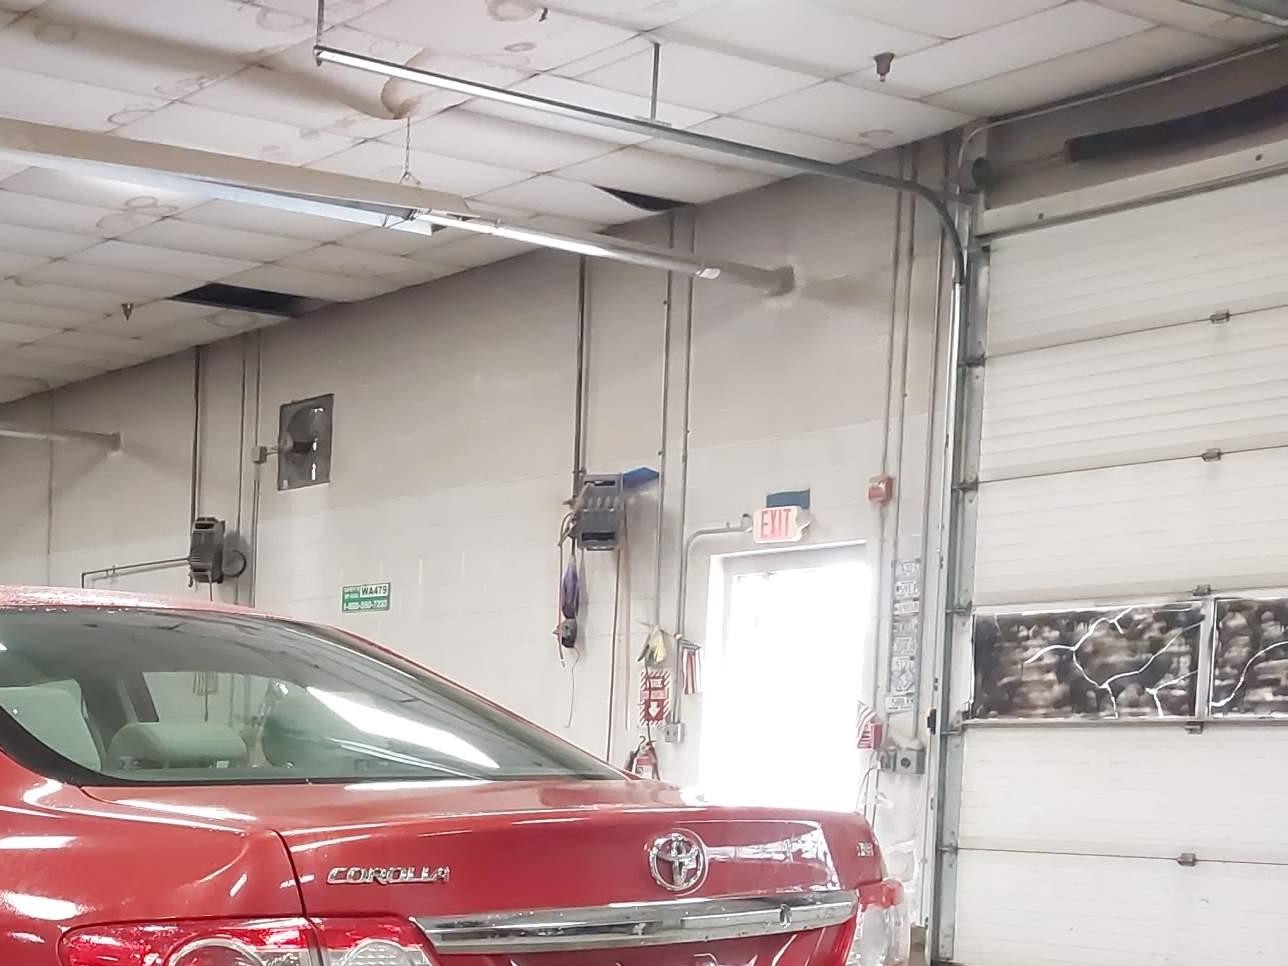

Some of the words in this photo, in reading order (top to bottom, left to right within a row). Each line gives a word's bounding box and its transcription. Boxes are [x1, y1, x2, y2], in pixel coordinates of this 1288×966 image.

[760, 508, 792, 538] EXIT
[362, 585, 387, 596] WA479
[326, 866, 450, 885] COROLLA
